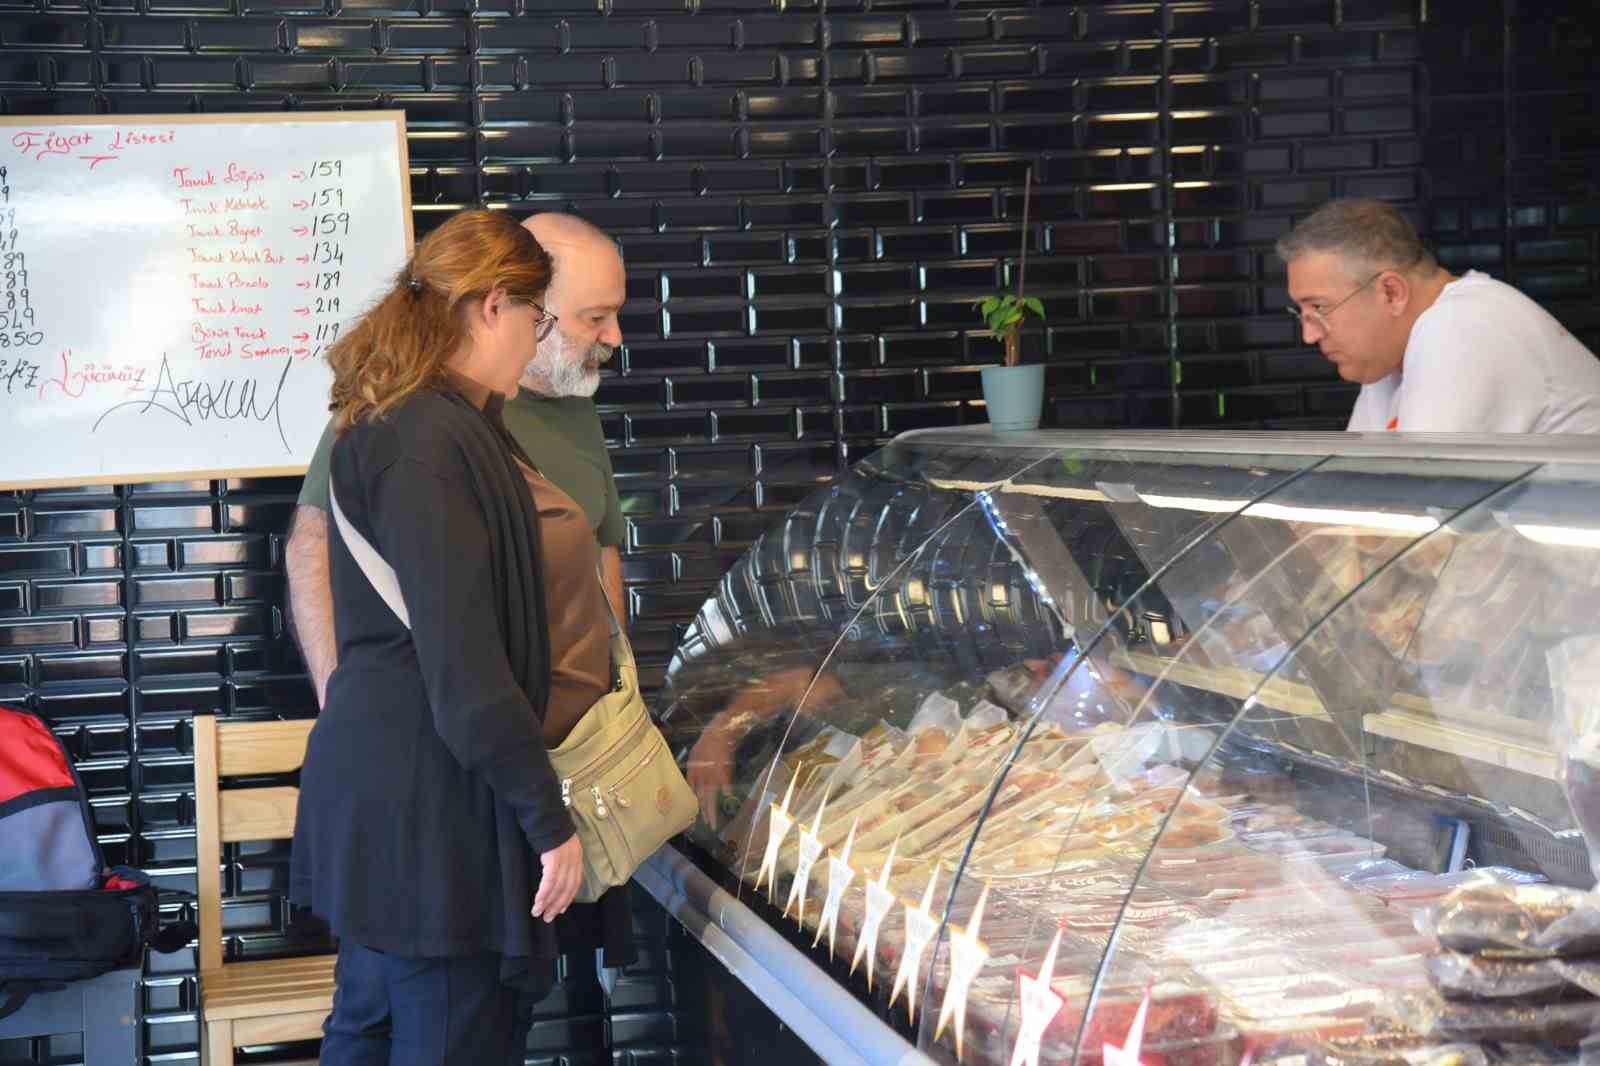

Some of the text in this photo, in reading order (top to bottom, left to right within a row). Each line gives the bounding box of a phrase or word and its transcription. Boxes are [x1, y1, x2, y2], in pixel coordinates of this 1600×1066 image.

[310, 160, 342, 179] 159
[311, 188, 344, 207] 159
[312, 212, 350, 236] 159
[312, 241, 344, 265] 134
[315, 271, 341, 291] 189
[315, 296, 341, 313] 219
[315, 322, 340, 342] 119
